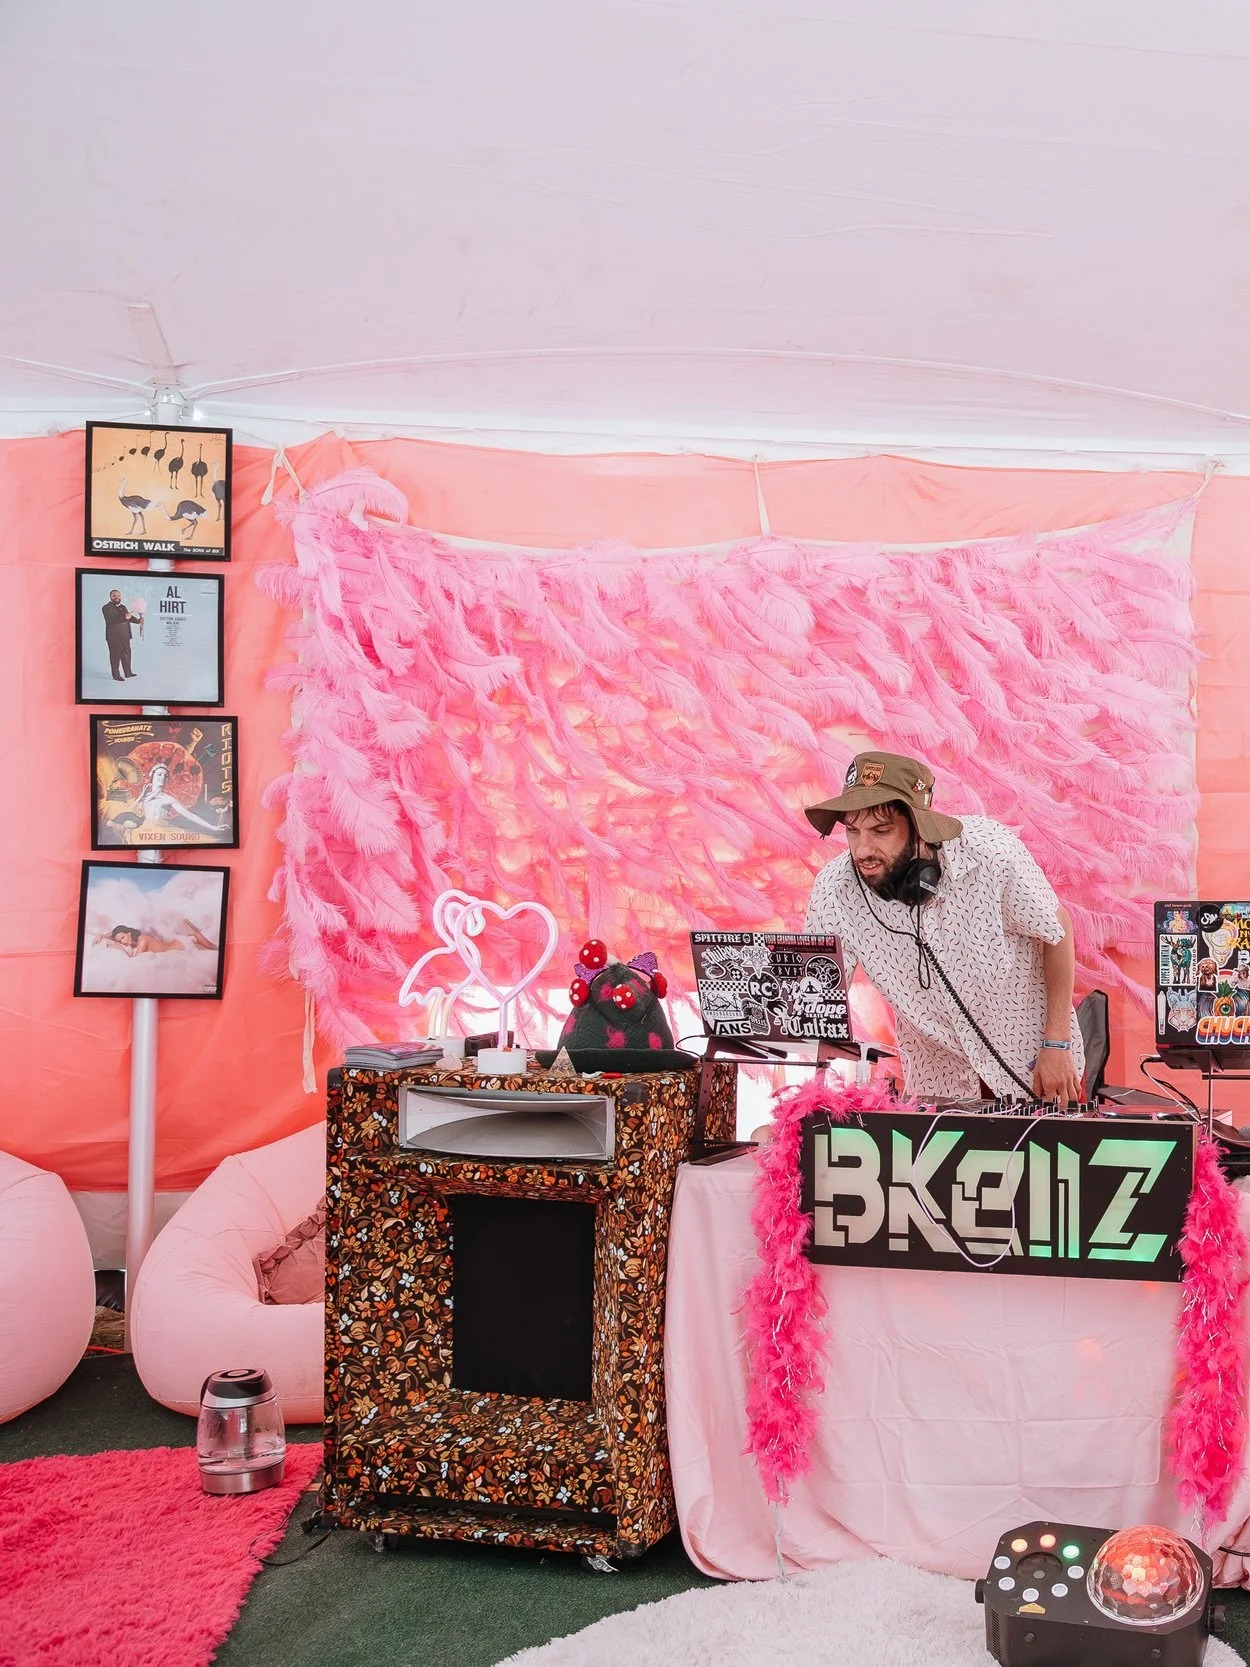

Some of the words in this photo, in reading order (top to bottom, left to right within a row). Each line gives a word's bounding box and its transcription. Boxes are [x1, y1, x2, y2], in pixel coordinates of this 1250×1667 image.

[92, 539, 138, 550] OSTRICH
[143, 541, 176, 552] WALK
[166, 585, 181, 598] AL
[160, 600, 187, 614] HIRT
[138, 832, 166, 841] VIXEN
[694, 933, 742, 943] SPITFIRE
[804, 1001, 847, 1017] dope
[788, 1015, 849, 1039] Colfax
